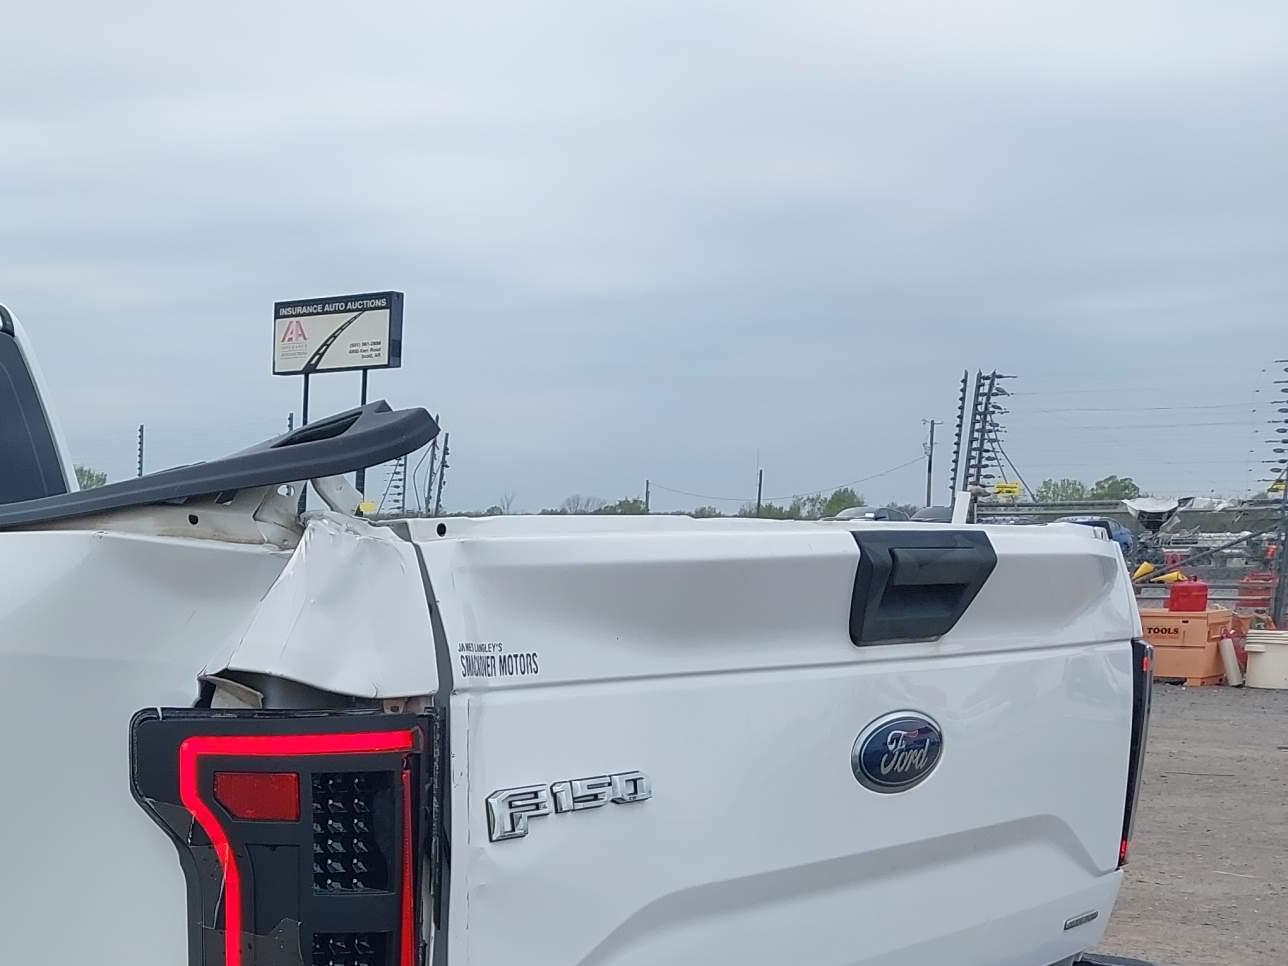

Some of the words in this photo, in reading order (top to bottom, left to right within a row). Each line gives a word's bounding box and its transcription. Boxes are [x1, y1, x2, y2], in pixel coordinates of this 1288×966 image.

[279, 304, 322, 315] INSURANCE
[324, 302, 345, 311] AUTO
[346, 298, 387, 309] AUCTIONS
[499, 652, 539, 676] MOTORS
[880, 729, 930, 775] Ford
[484, 770, 654, 843] F150
